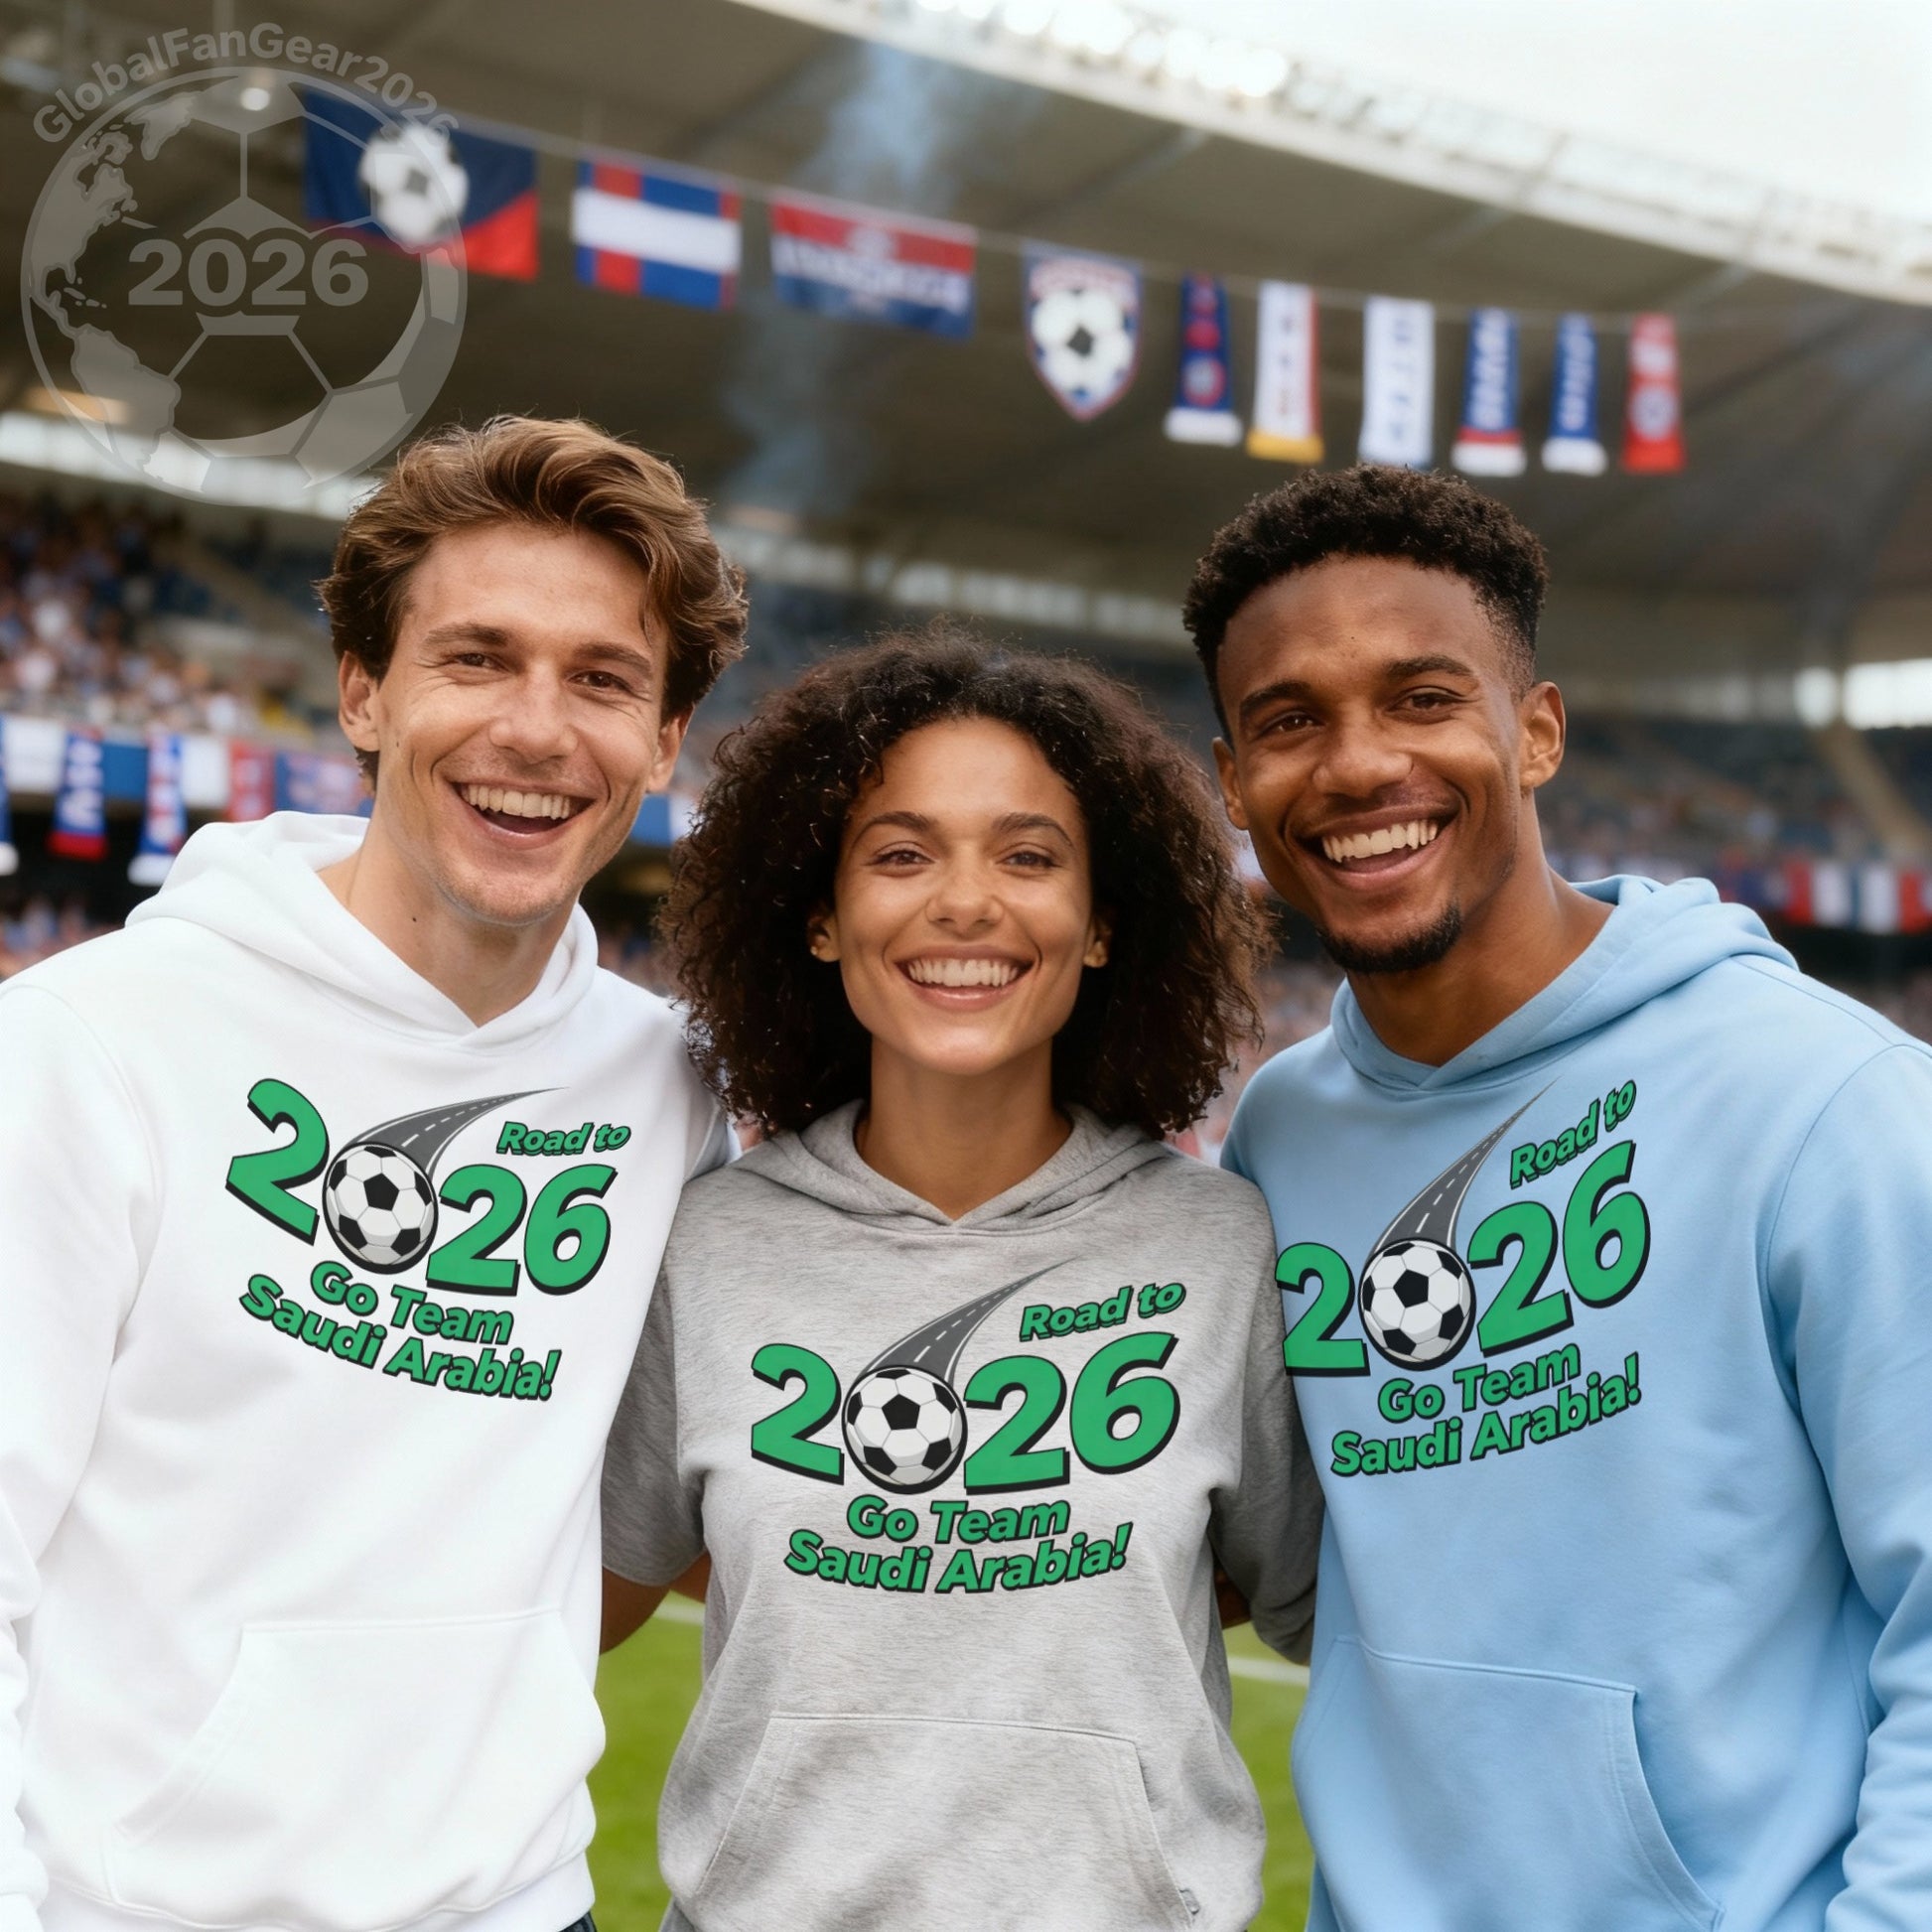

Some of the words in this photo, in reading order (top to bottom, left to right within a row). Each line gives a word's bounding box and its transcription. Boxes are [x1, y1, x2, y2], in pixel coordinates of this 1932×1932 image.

[496, 1121, 594, 1155] Road
[594, 1122, 631, 1150] to
[1510, 1099, 1599, 1188] Road
[1603, 1079, 1637, 1132] to
[238, 1274, 387, 1368] Saudi
[383, 1337, 562, 1401] Arabia!
[310, 1260, 379, 1315] Go
[390, 1285, 514, 1344] Team
[1020, 1286, 1134, 1341] Road
[1137, 1283, 1186, 1318] to
[1330, 1417, 1462, 1476] Saudi
[1469, 1351, 1641, 1460] Arabia!
[1378, 1377, 1445, 1423] Go
[1453, 1343, 1581, 1412] Team
[784, 1529, 933, 1592] Saudi
[935, 1521, 1134, 1593] Arabia!
[846, 1494, 918, 1542] Go
[929, 1499, 1071, 1544] Team
